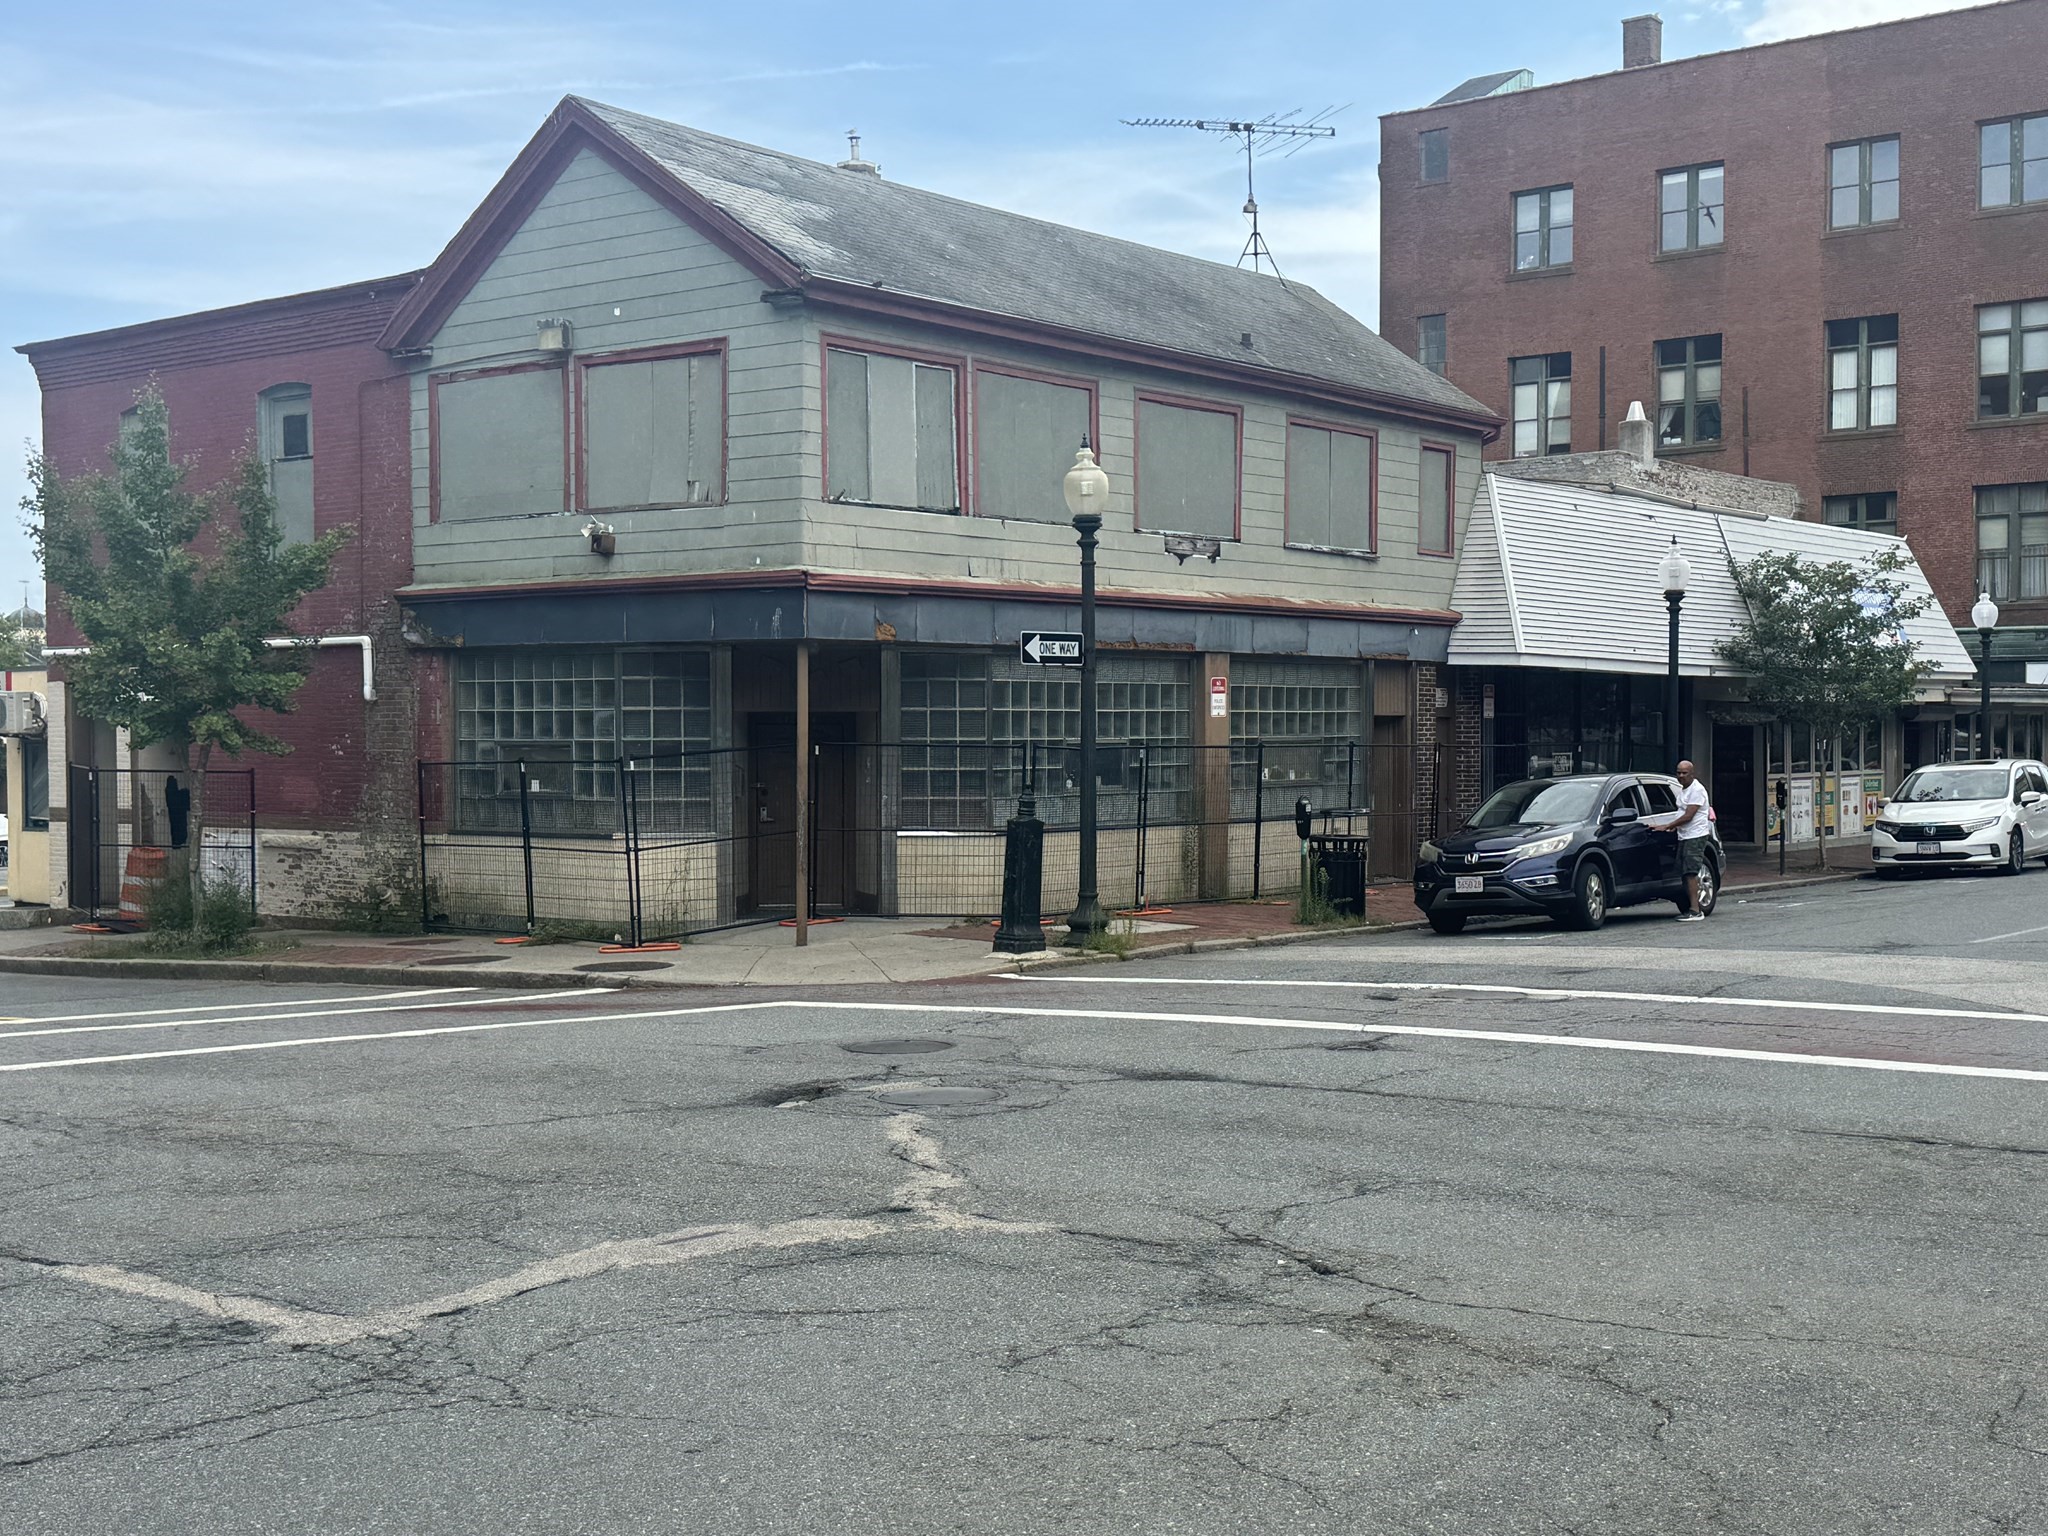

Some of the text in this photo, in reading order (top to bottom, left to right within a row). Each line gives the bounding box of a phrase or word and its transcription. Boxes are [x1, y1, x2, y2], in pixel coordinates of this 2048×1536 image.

[1040, 642, 1077, 655] ONE WAY
[1554, 755, 1567, 763] FOR
[1553, 763, 1569, 772] RENT
